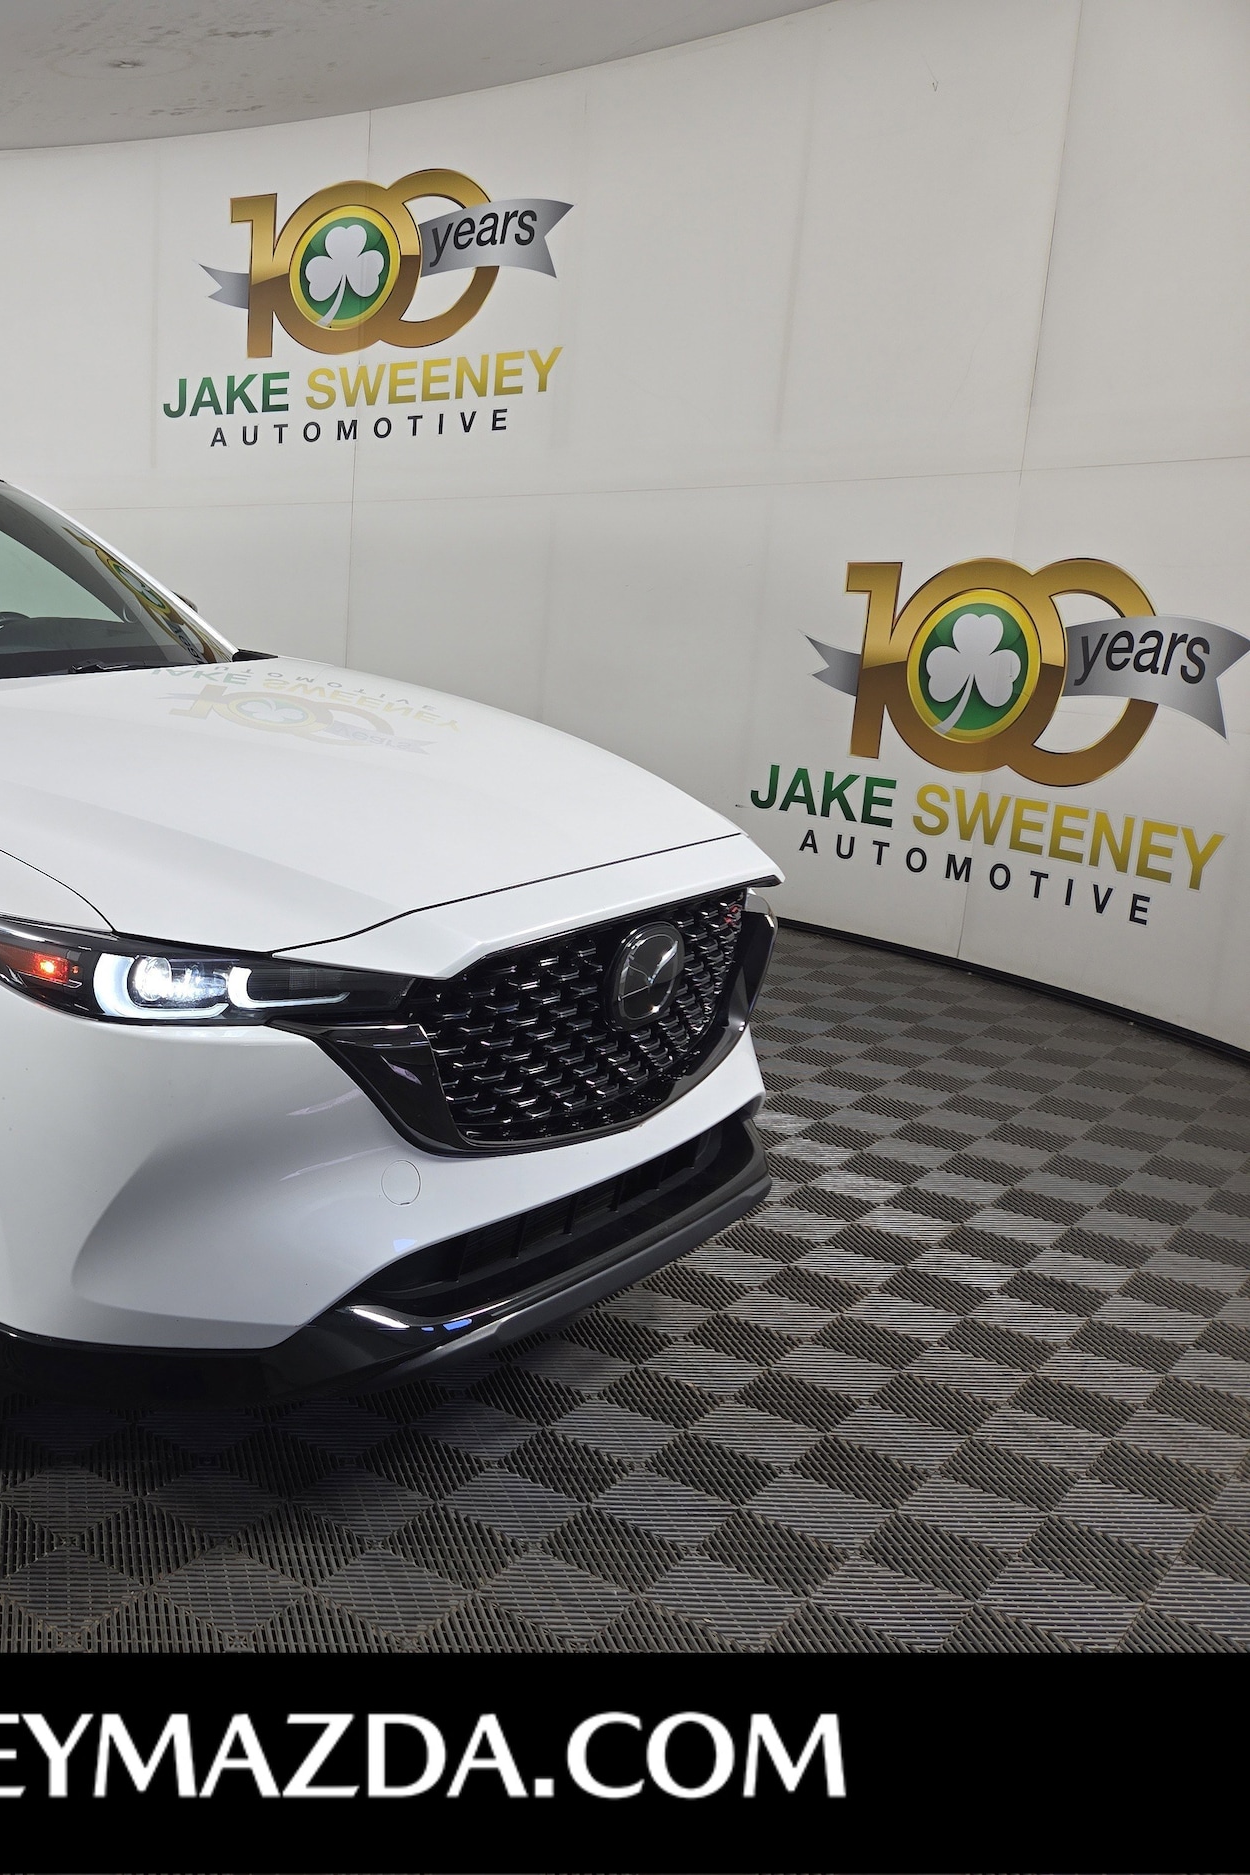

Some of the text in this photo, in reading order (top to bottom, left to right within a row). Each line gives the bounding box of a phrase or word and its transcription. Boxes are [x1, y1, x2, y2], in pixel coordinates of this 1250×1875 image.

[229, 168, 538, 358] 100 years
[163, 346, 563, 419] JAKE SWEENEY
[210, 408, 508, 447] AUTOMOTIVE
[845, 557, 1211, 788] 100 years
[750, 764, 1226, 891] JAKE SWEENEY
[799, 829, 1151, 926] AUTOMOTIVE
